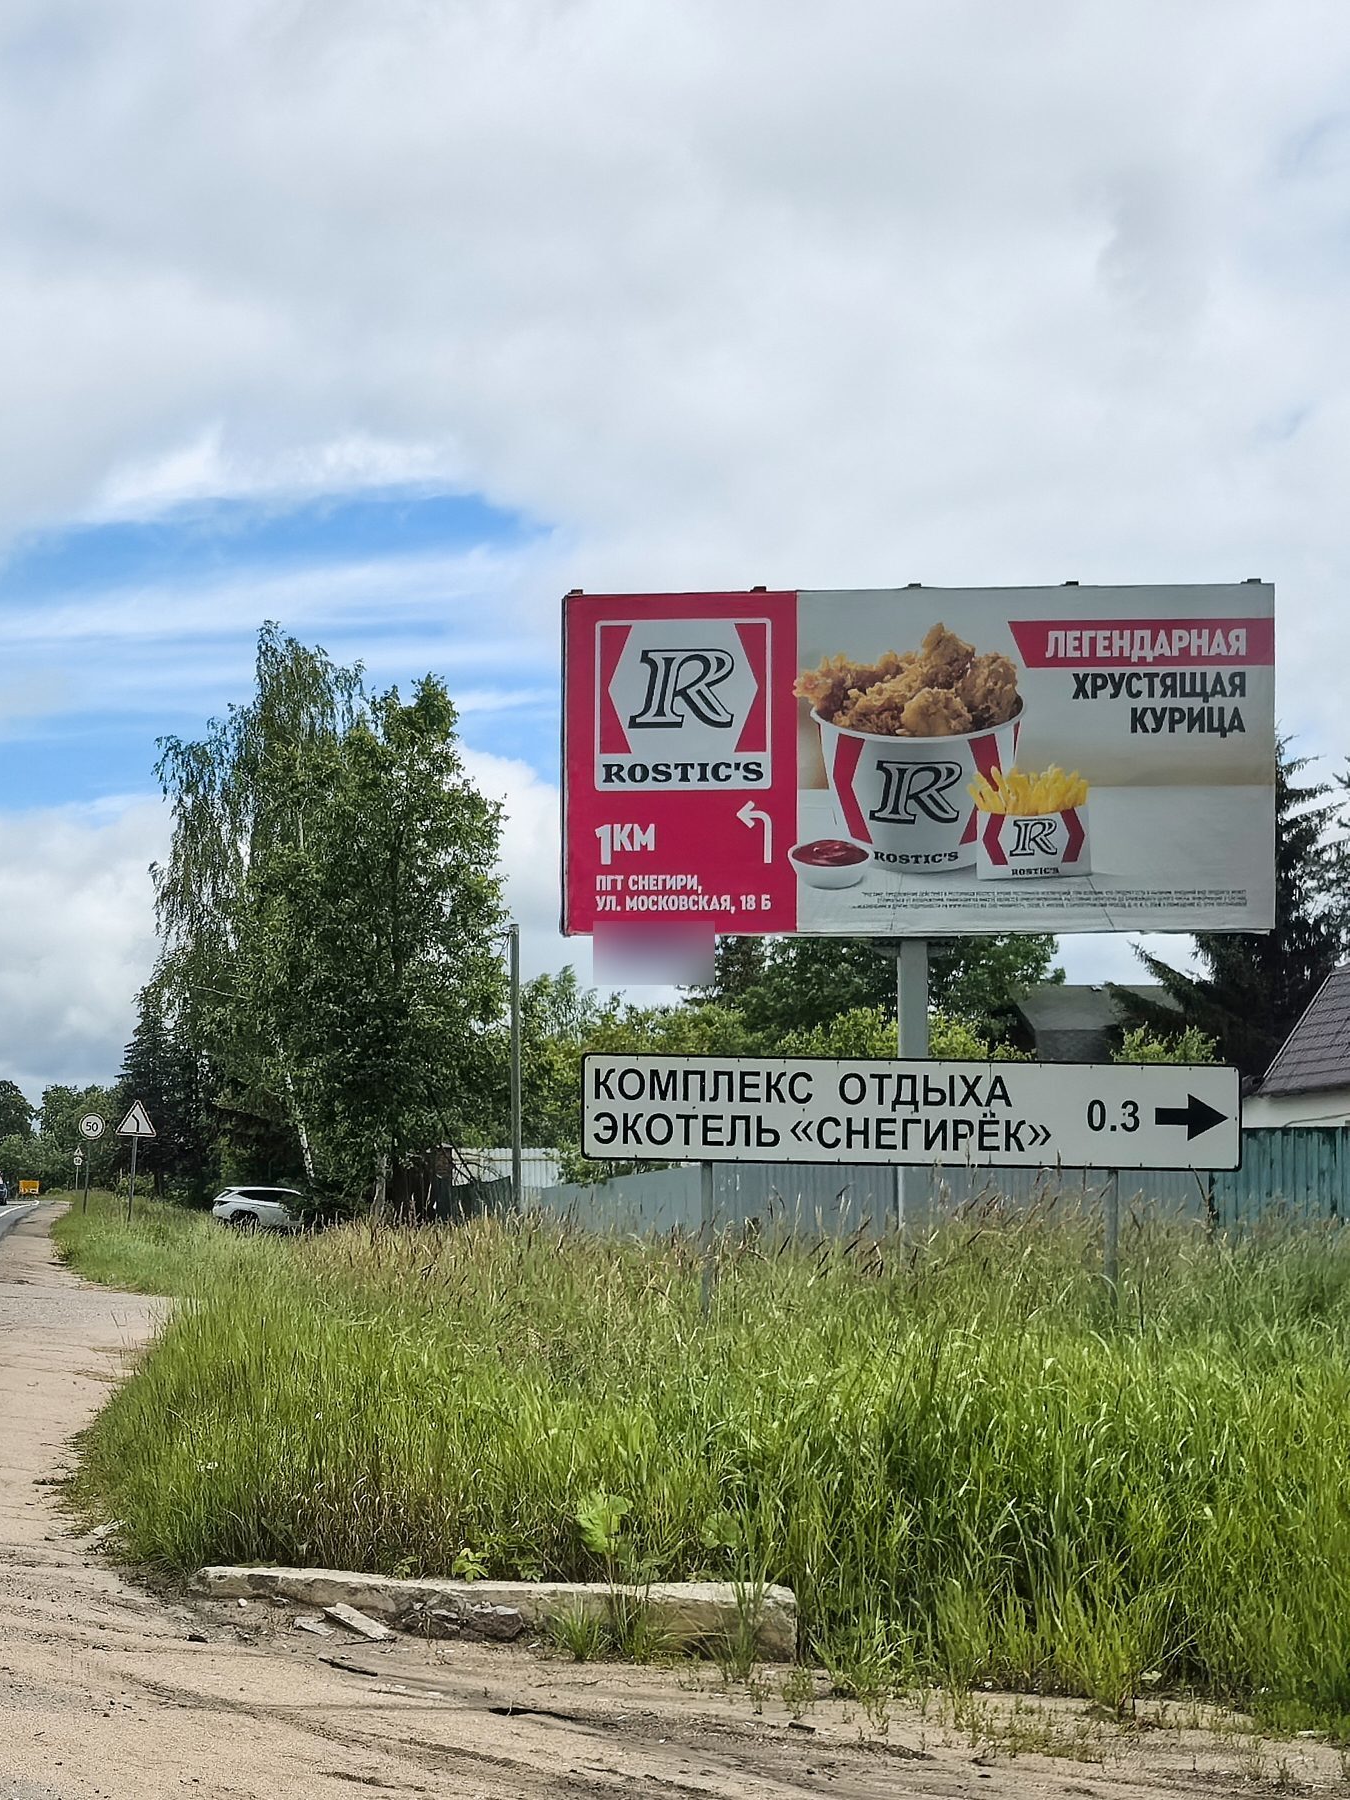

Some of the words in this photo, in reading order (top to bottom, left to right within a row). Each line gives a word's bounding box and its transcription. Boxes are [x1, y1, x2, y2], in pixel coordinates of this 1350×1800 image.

[1045, 628, 1247, 662] ЛЕГЕНДАРНАЯ
[628, 649, 734, 728] R
[1072, 671, 1246, 703] ХРУСТЯЩАЯ
[1130, 706, 1246, 738] КУРИЦА
[602, 762, 764, 783] ROSTIC'S
[873, 851, 959, 865] ROSTIC'S
[595, 874, 623, 891] ПГТ
[628, 874, 702, 894] СНЕГИРИ,
[595, 895, 621, 911] УЛ.
[625, 895, 736, 914] МОСКОВСКАЯ,
[740, 895, 756, 910] 18
[761, 894, 771, 910] Б
[594, 1068, 813, 1104] КОМПЛЕКС
[838, 1073, 1012, 1112] ОТДЫХА
[85, 1121, 99, 1132] 50
[1087, 1099, 1140, 1132] 0.3
[593, 1112, 781, 1147] ЭКОТЕЛЬ
[790, 1112, 1052, 1152] «СНЕГИРЁК»
